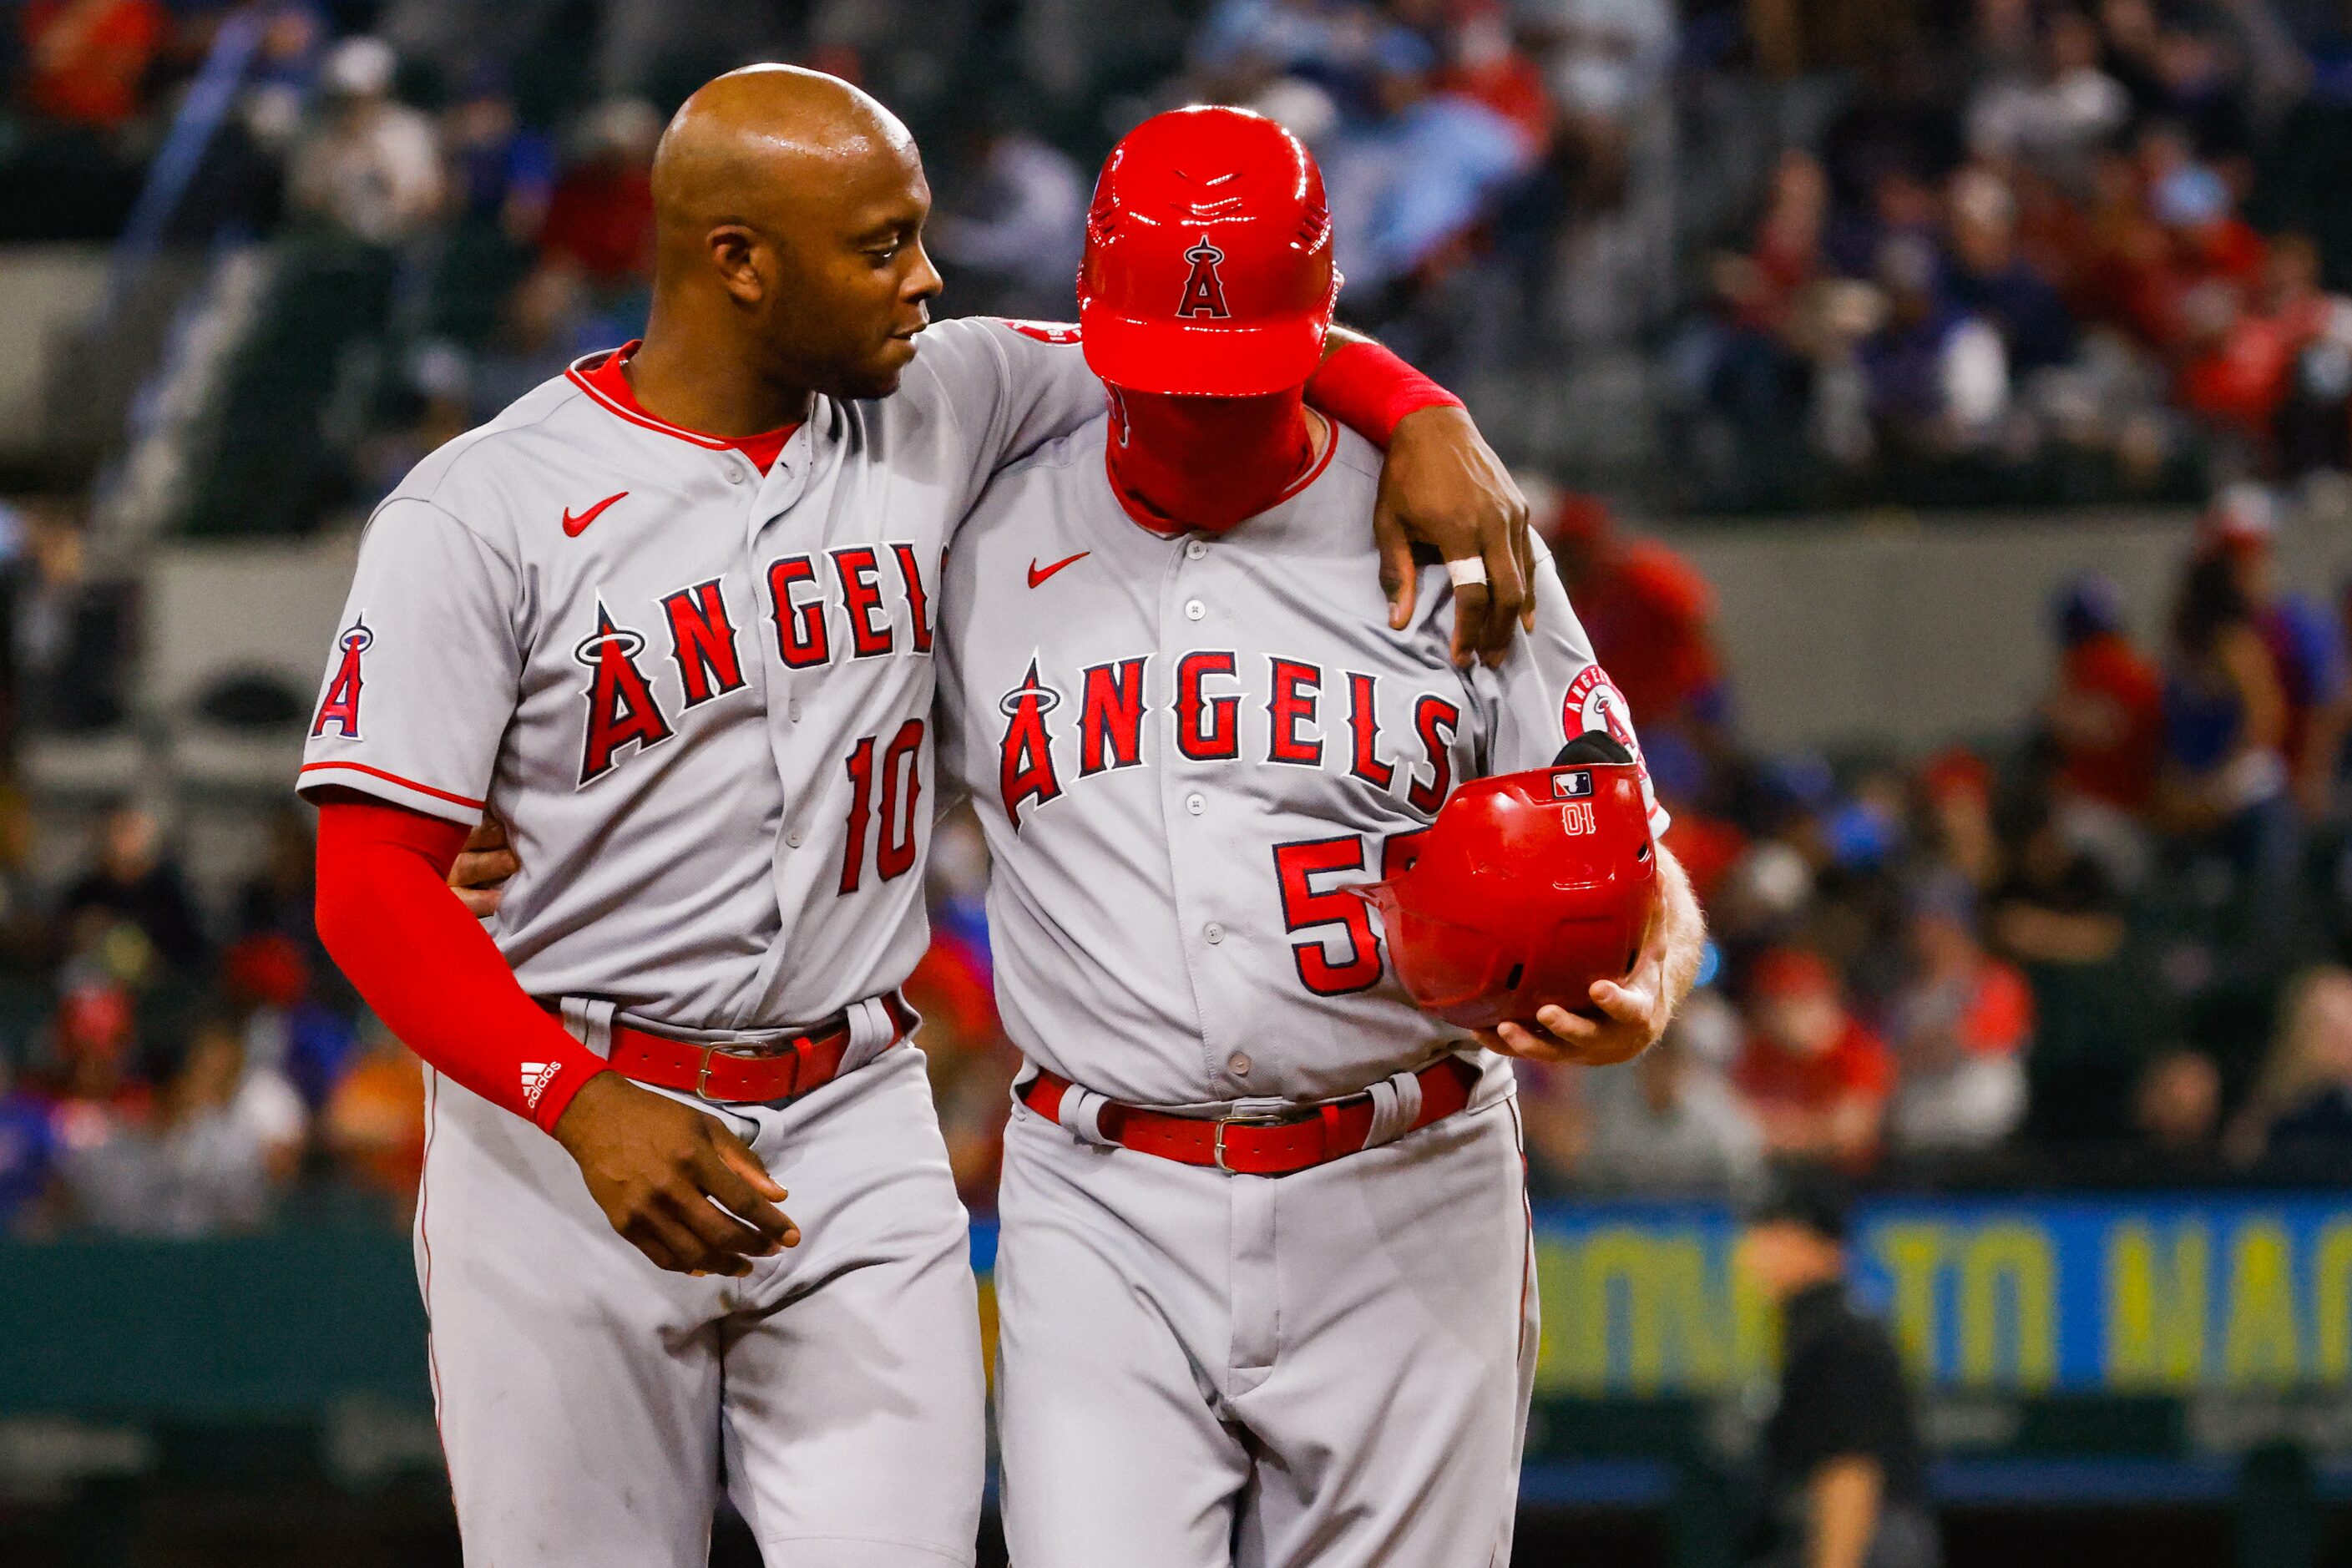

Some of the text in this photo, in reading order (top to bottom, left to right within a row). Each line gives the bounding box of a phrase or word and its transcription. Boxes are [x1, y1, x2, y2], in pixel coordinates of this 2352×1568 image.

[1175, 232, 1232, 318] A
[310, 609, 375, 742] A
[571, 539, 948, 791] ANGEL
[999, 646, 1464, 842] ANGELS
[837, 717, 922, 898] 10
[1272, 825, 1433, 997] 5
[528, 1061, 561, 1109] adidas
